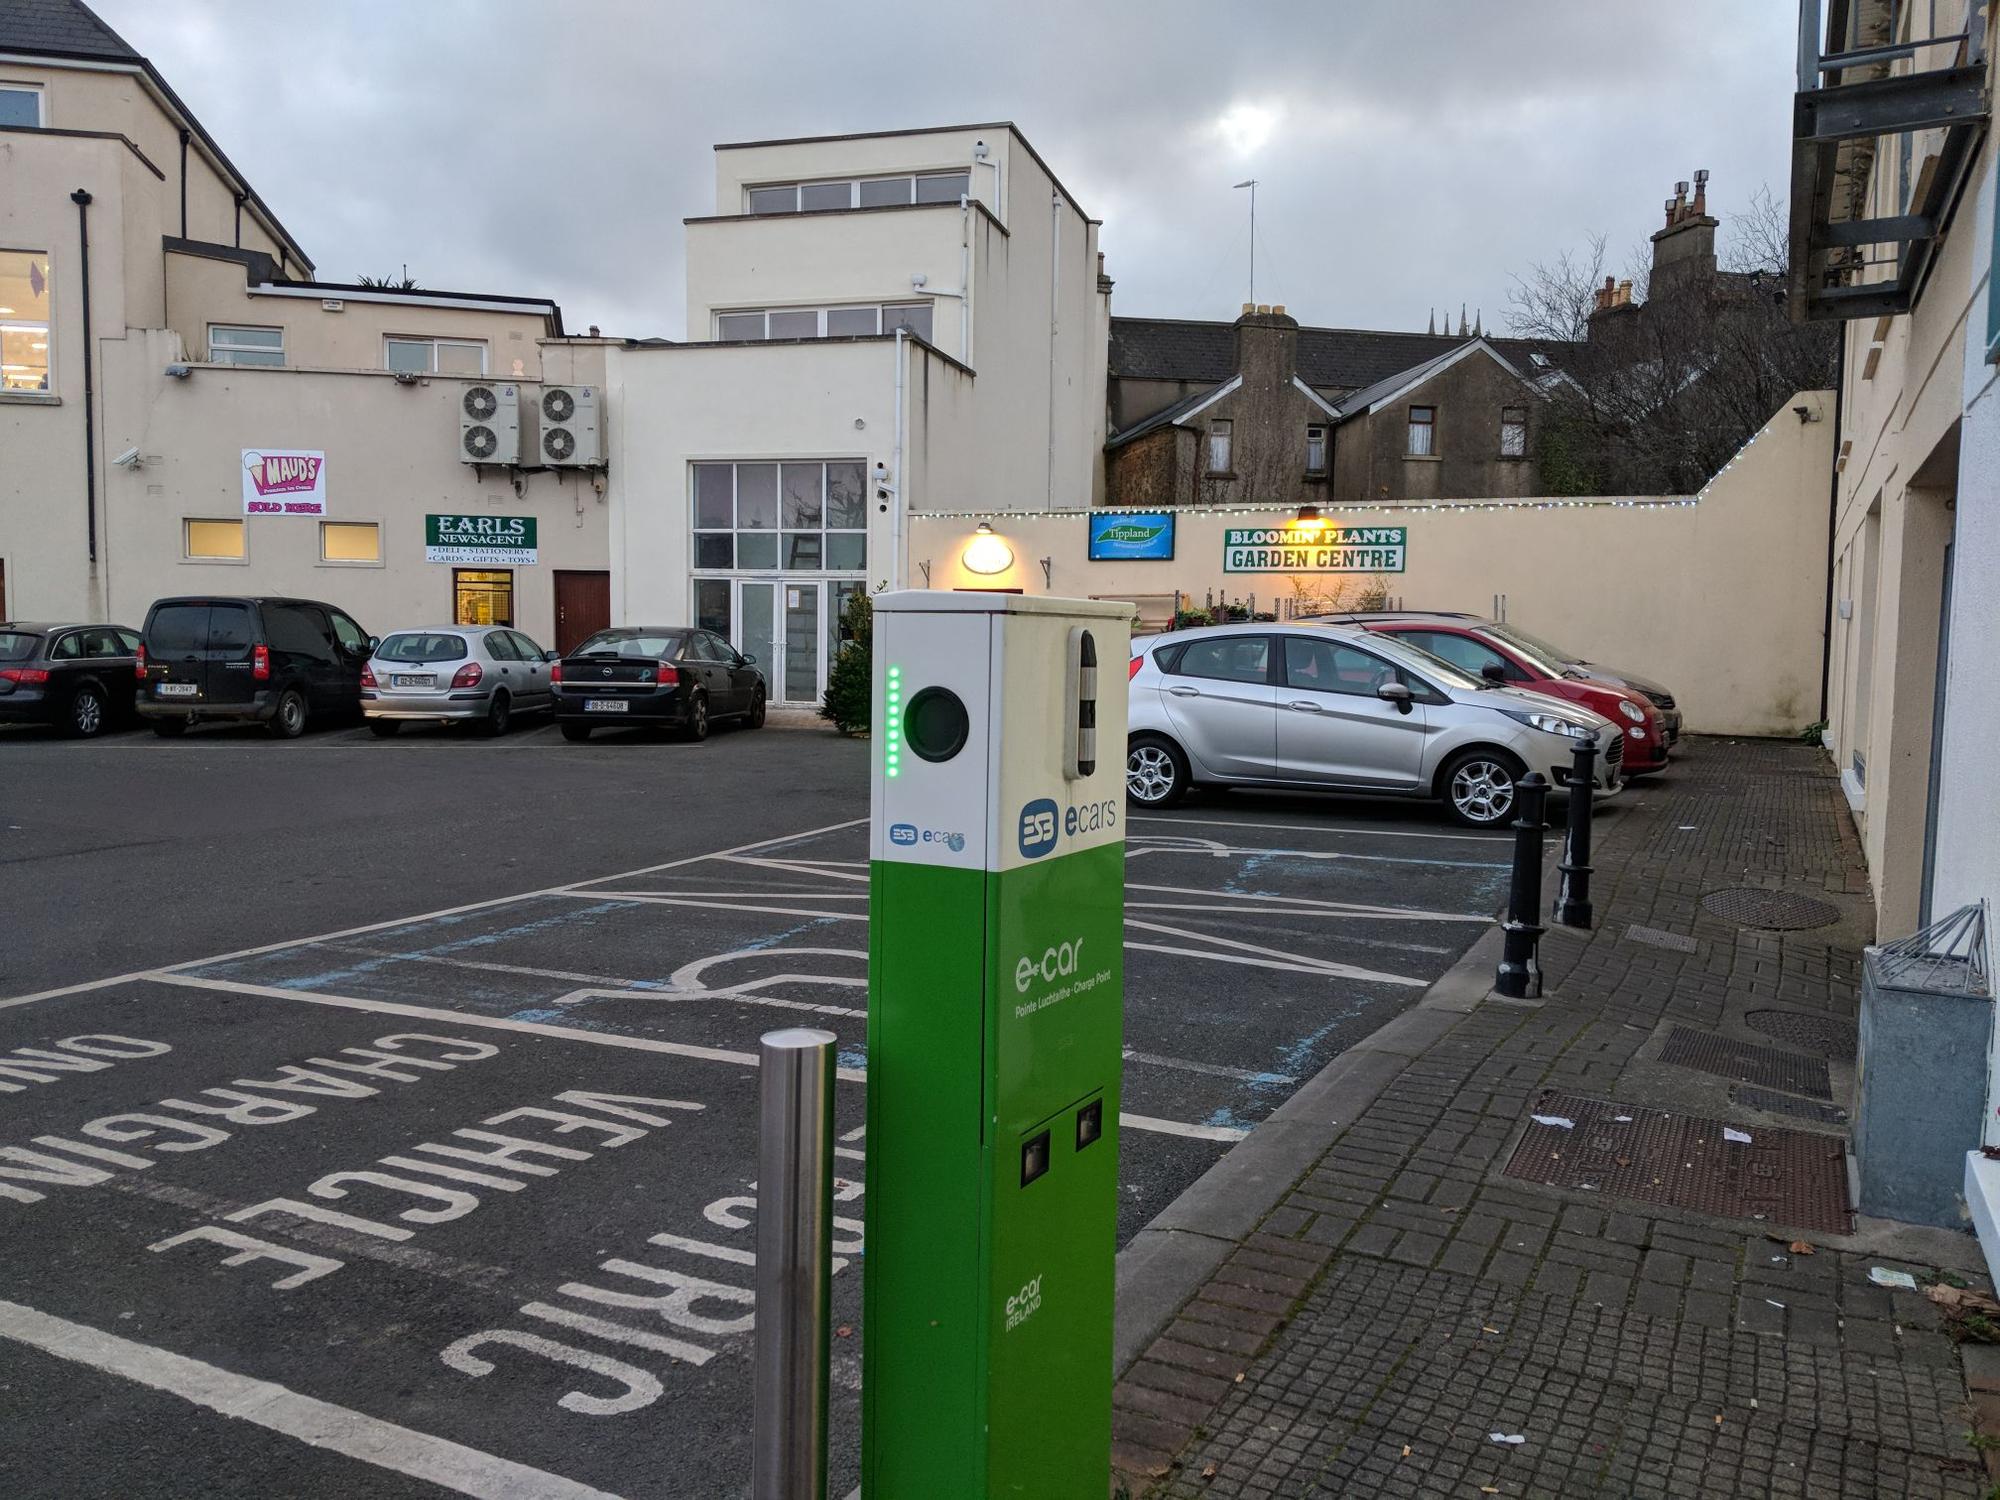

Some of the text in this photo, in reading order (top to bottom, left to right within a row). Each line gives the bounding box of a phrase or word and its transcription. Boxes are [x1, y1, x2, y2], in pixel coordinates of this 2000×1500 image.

[266, 457, 316, 486] MAUD'S
[248, 502, 322, 513] SOLD HERE
[438, 516, 525, 535] EARLS
[1109, 528, 1150, 540] Tippland
[438, 534, 525, 545] NEWSAGENT
[1230, 530, 1402, 544] BLOOMIN' PLANTS
[469, 547, 525, 555] STATIONERY
[1232, 550, 1397, 568] GARDEN CENTRE
[1065, 799, 1116, 836] ecars
[1015, 1001, 1038, 1018] Pointe
[1074, 977, 1095, 993] Charge
[1096, 969, 1111, 984] Point
[147, 1090, 706, 1290] VEHICLE
[1006, 1294, 1042, 1333] IRELAND
